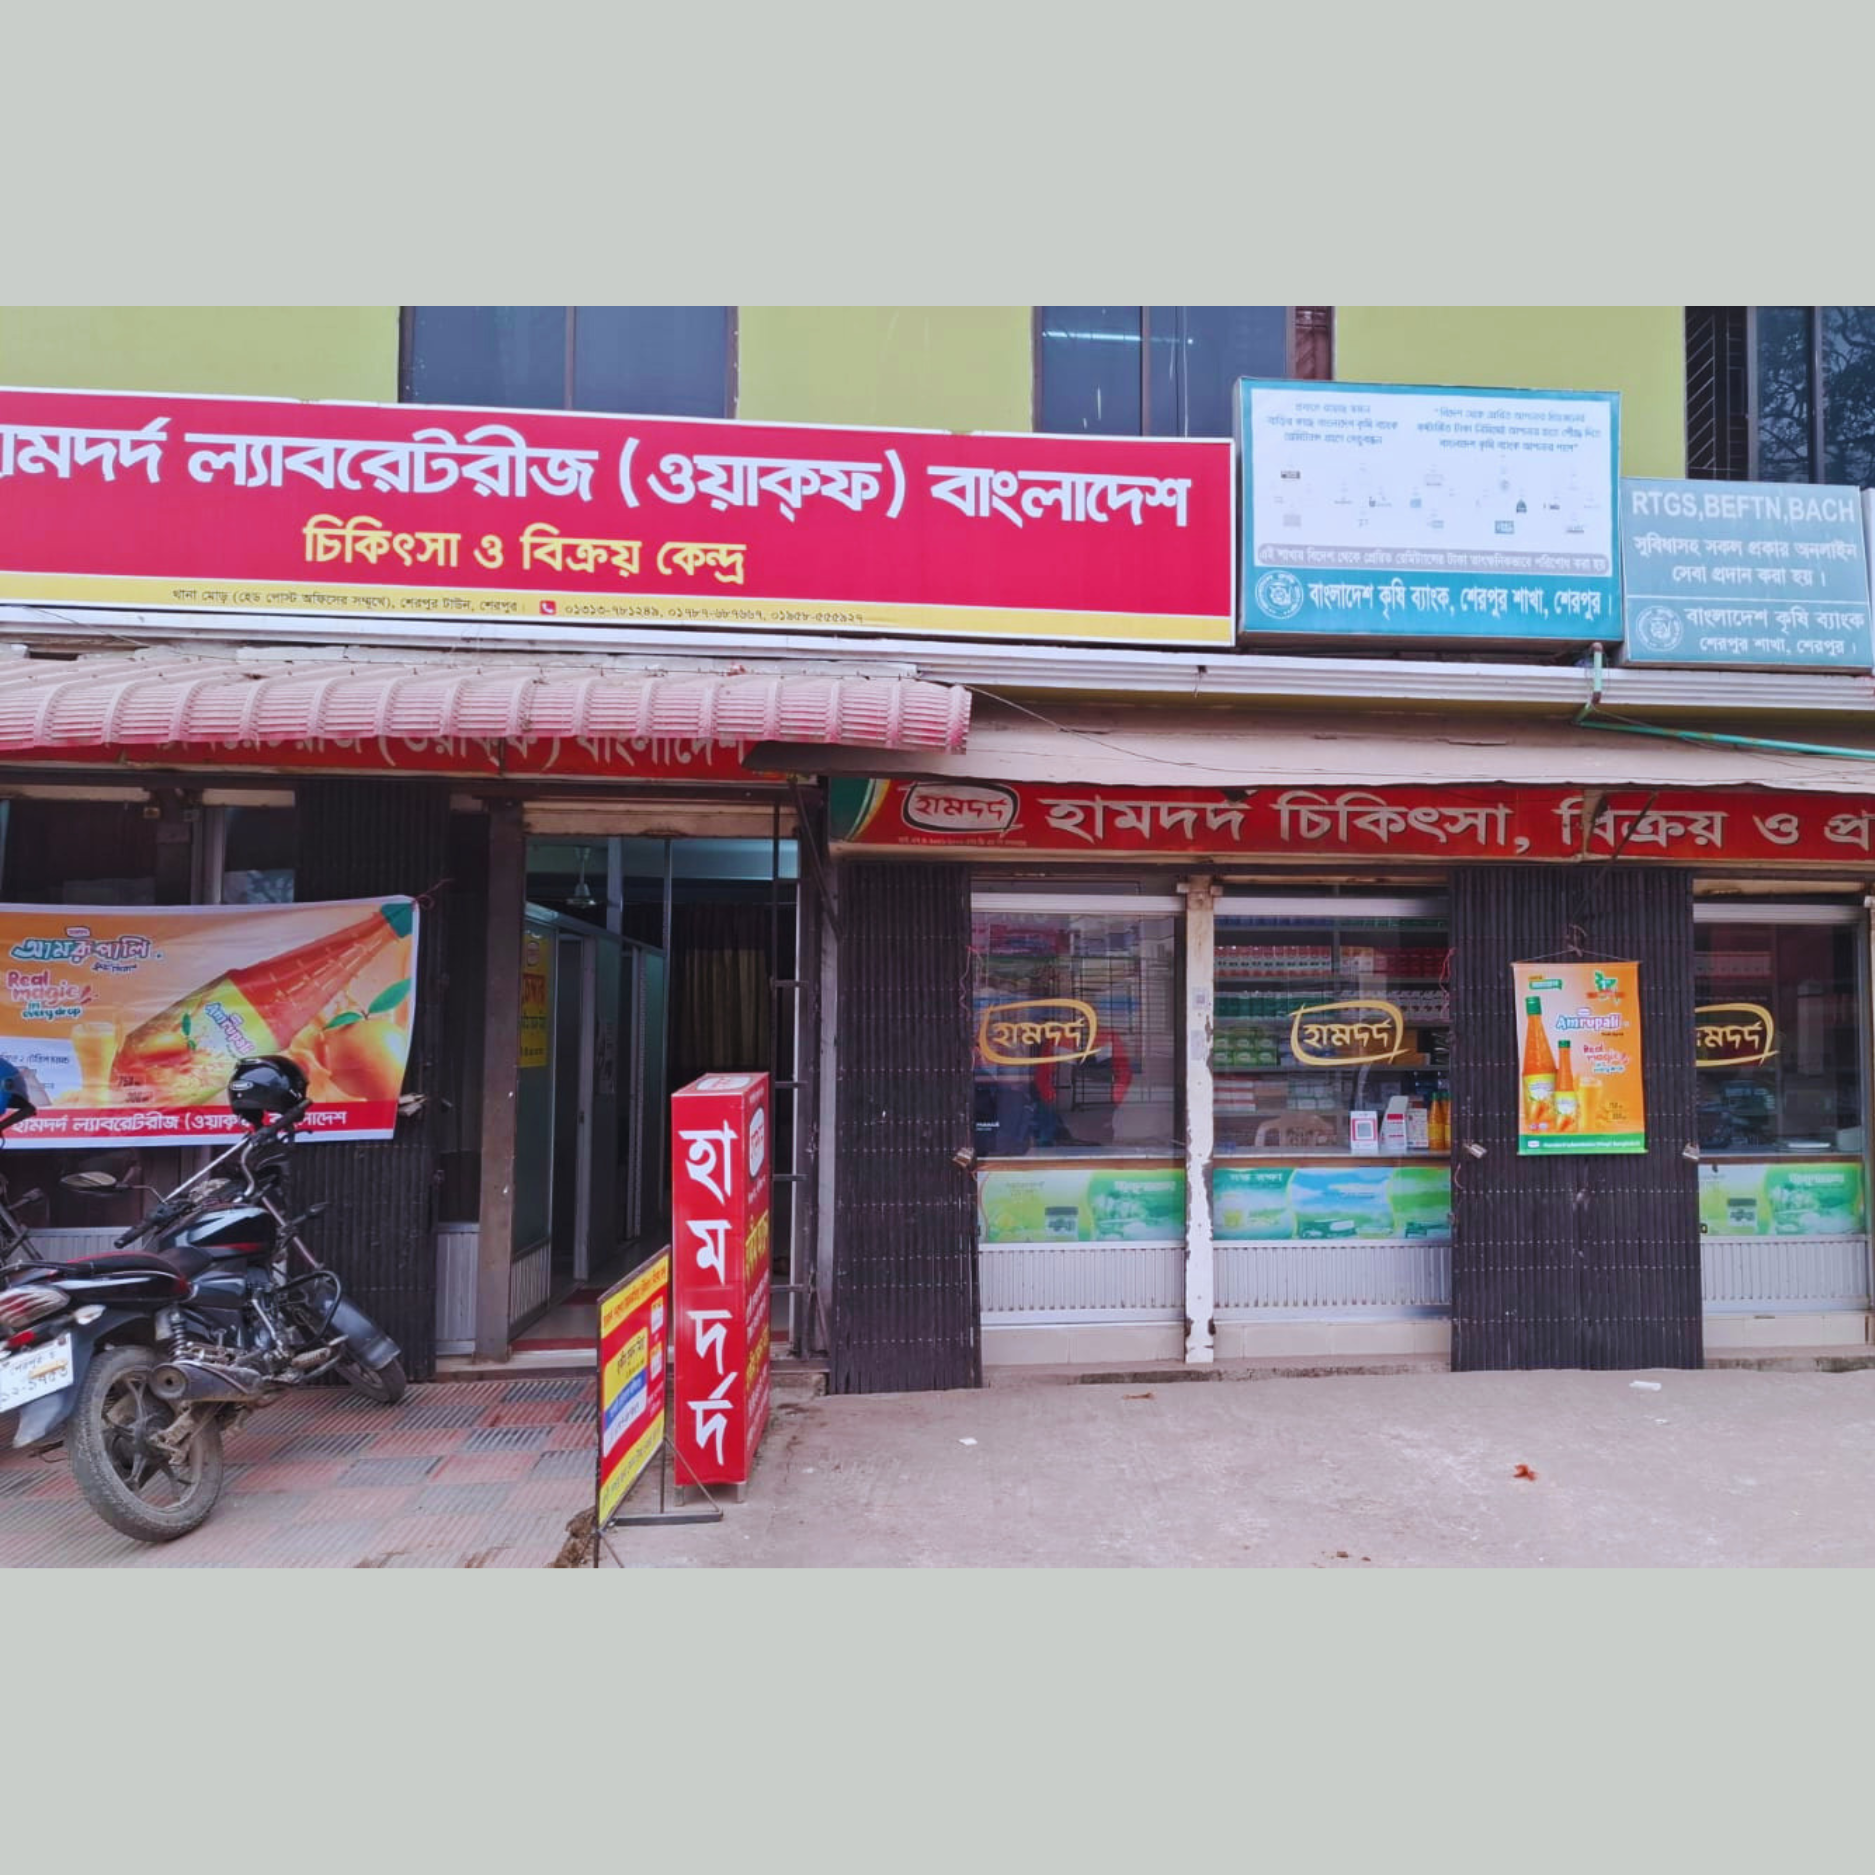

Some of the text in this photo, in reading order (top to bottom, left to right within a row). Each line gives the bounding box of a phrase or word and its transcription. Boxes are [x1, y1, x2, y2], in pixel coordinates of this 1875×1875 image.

[0, 417, 171, 484] ামদর্দ
[185, 425, 600, 501] ল্যাবরেটরীজ
[927, 465, 1192, 528] বাংলাদেশ
[303, 514, 747, 585] চিকিৎসা ও বিক্রয় কেন্দ্র
[1672, 565, 1707, 583] সেবা
[1711, 566, 1753, 585] প্রদান
[1757, 568, 1786, 586] করা
[1791, 570, 1813, 587] হয়
[401, 597, 438, 611] শেরপুর
[1307, 580, 1374, 610] বাংলাদেশ
[1377, 576, 1407, 621] কৃষি
[1410, 583, 1455, 617] ব্যাংক,
[1460, 584, 1509, 618] শেরপুর
[1511, 586, 1549, 620] শাখা,
[1553, 588, 1602, 622] শেরপুর
[1683, 605, 1865, 634] বাংলাদেশ কৃষি ব্যাংক
[1699, 637, 1748, 655] শেরপুর
[1796, 639, 1845, 657] শেরপুর
[915, 795, 1008, 820] হামদর্দ
[1269, 790, 1531, 855] চিকিৎসা,
[1551, 796, 1730, 848] বিক্রয়
[1752, 812, 1800, 845] ও
[1823, 810, 1875, 851] প্র
[7, 970, 49, 988] Real
[13, 981, 80, 1004] magic
[23, 1006, 81, 1020] every drop
[1556, 1013, 1620, 1031] Amrupali
[992, 1018, 1085, 1047] হামদর্দ
[1303, 1018, 1392, 1048] হামদর্দ
[1696, 1021, 1763, 1050] ামদর্দ
[11, 1115, 69, 1133] হামদর্দ
[73, 1111, 180, 1132] ল্যাবরেটরীজ
